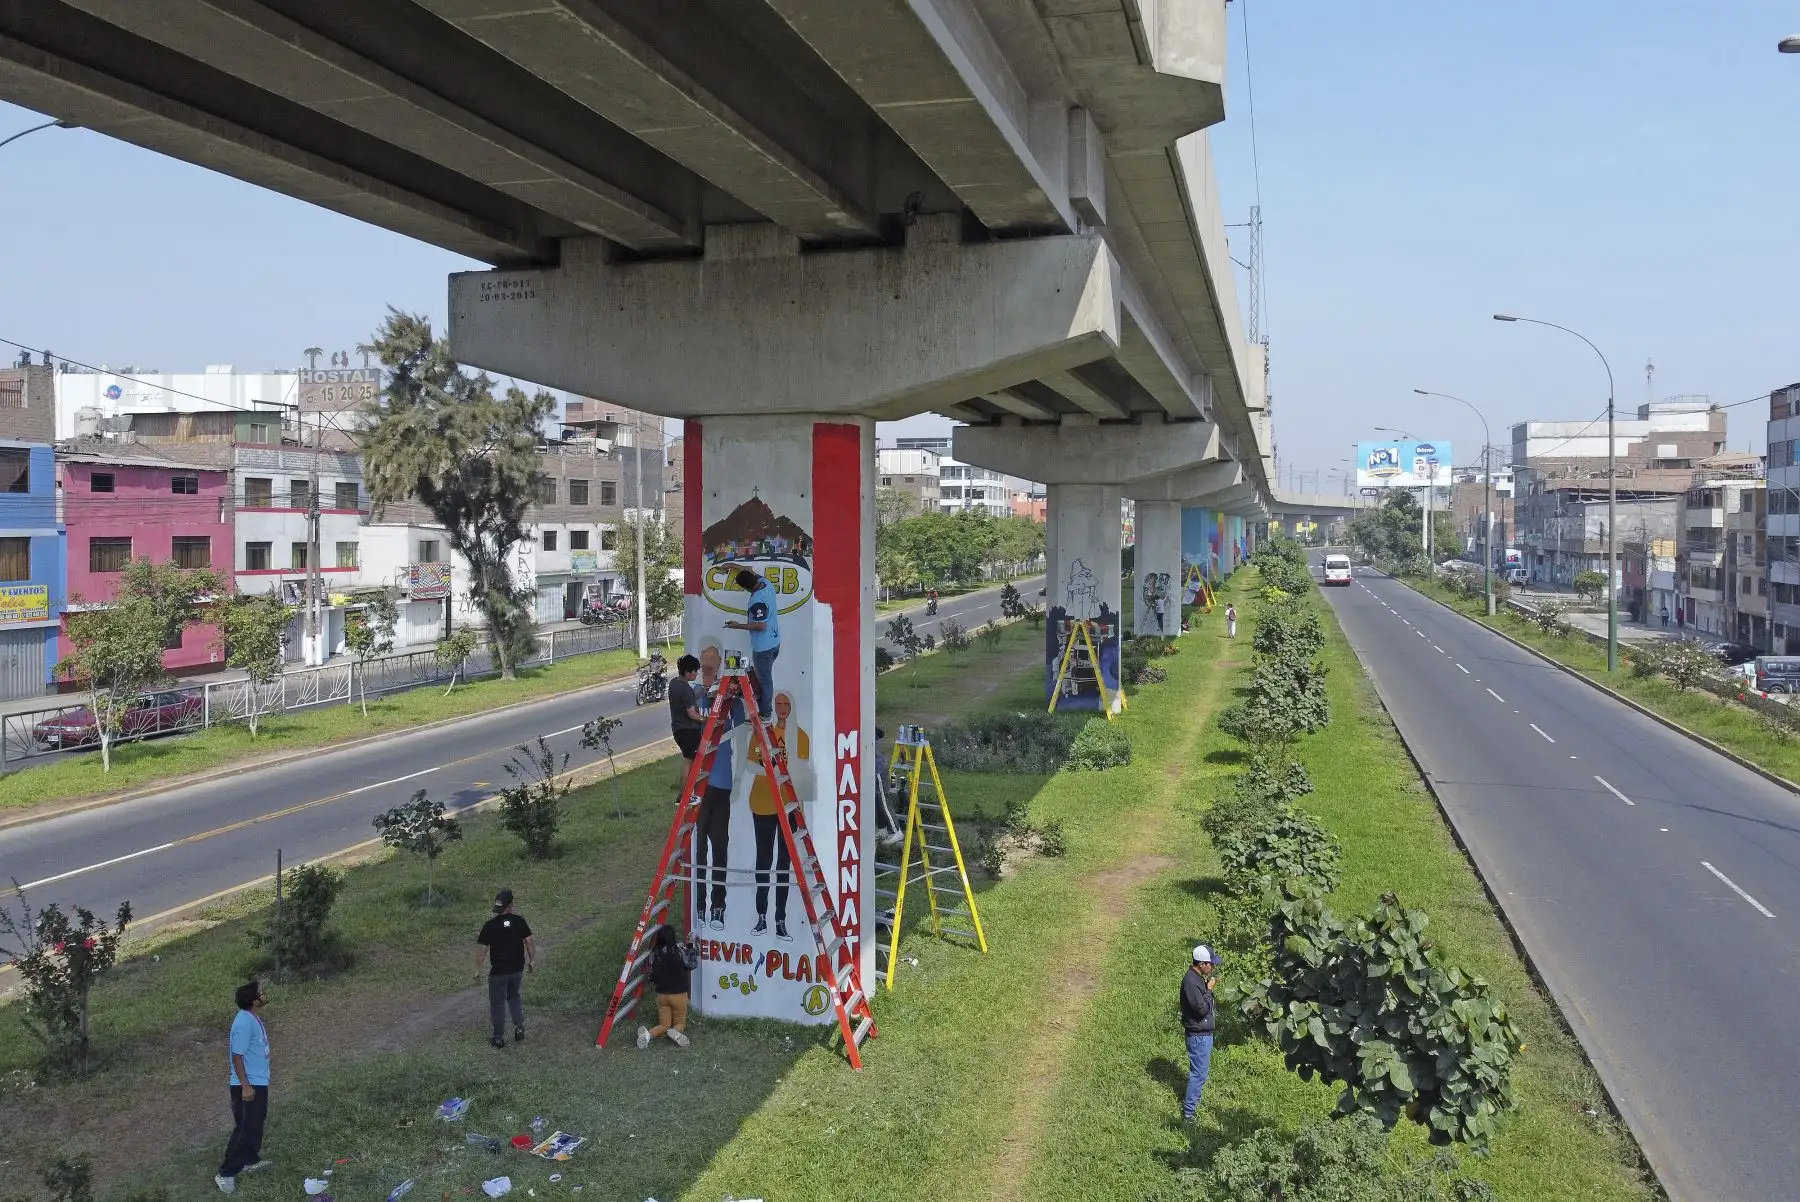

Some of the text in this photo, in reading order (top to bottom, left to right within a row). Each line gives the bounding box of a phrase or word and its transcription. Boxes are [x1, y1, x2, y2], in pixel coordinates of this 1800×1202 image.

[300, 370, 375, 383] HOSTAL
[321, 386, 333, 402] 15
[340, 386, 354, 401] 20
[360, 385, 372, 400] 25
[8, 587, 45, 596] EVENTOS
